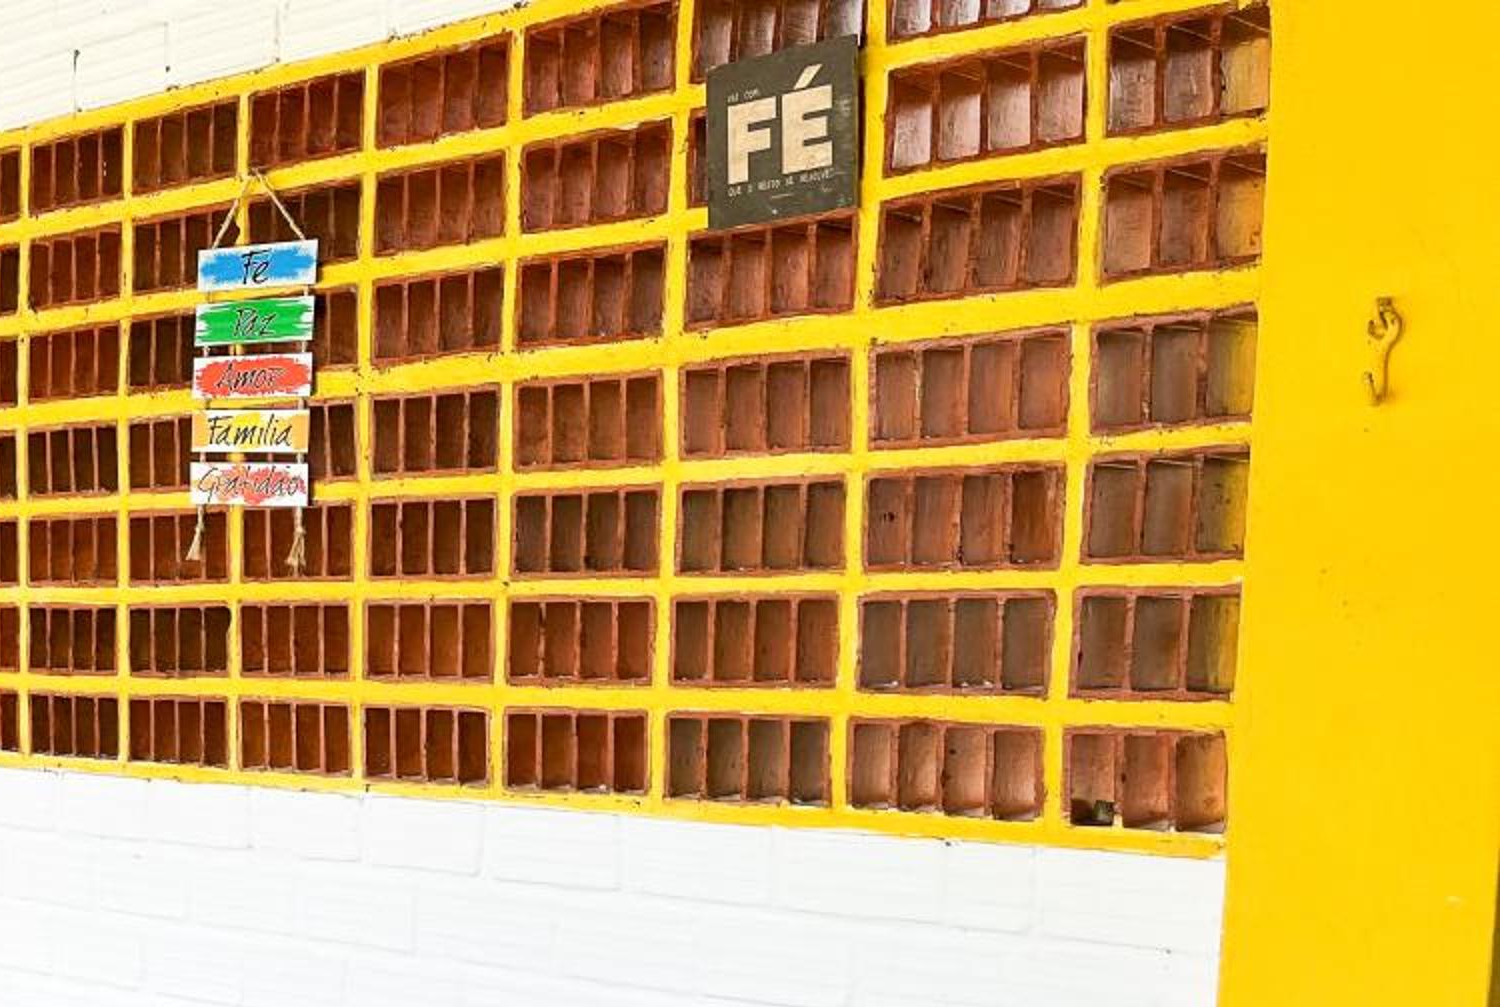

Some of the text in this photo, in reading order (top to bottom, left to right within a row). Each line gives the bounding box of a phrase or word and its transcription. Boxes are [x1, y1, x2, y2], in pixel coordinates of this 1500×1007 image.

[727, 63, 833, 186] FÉ
[232, 306, 277, 336] Paz
[213, 362, 286, 391] Amor
[197, 465, 301, 502] Gratidão
